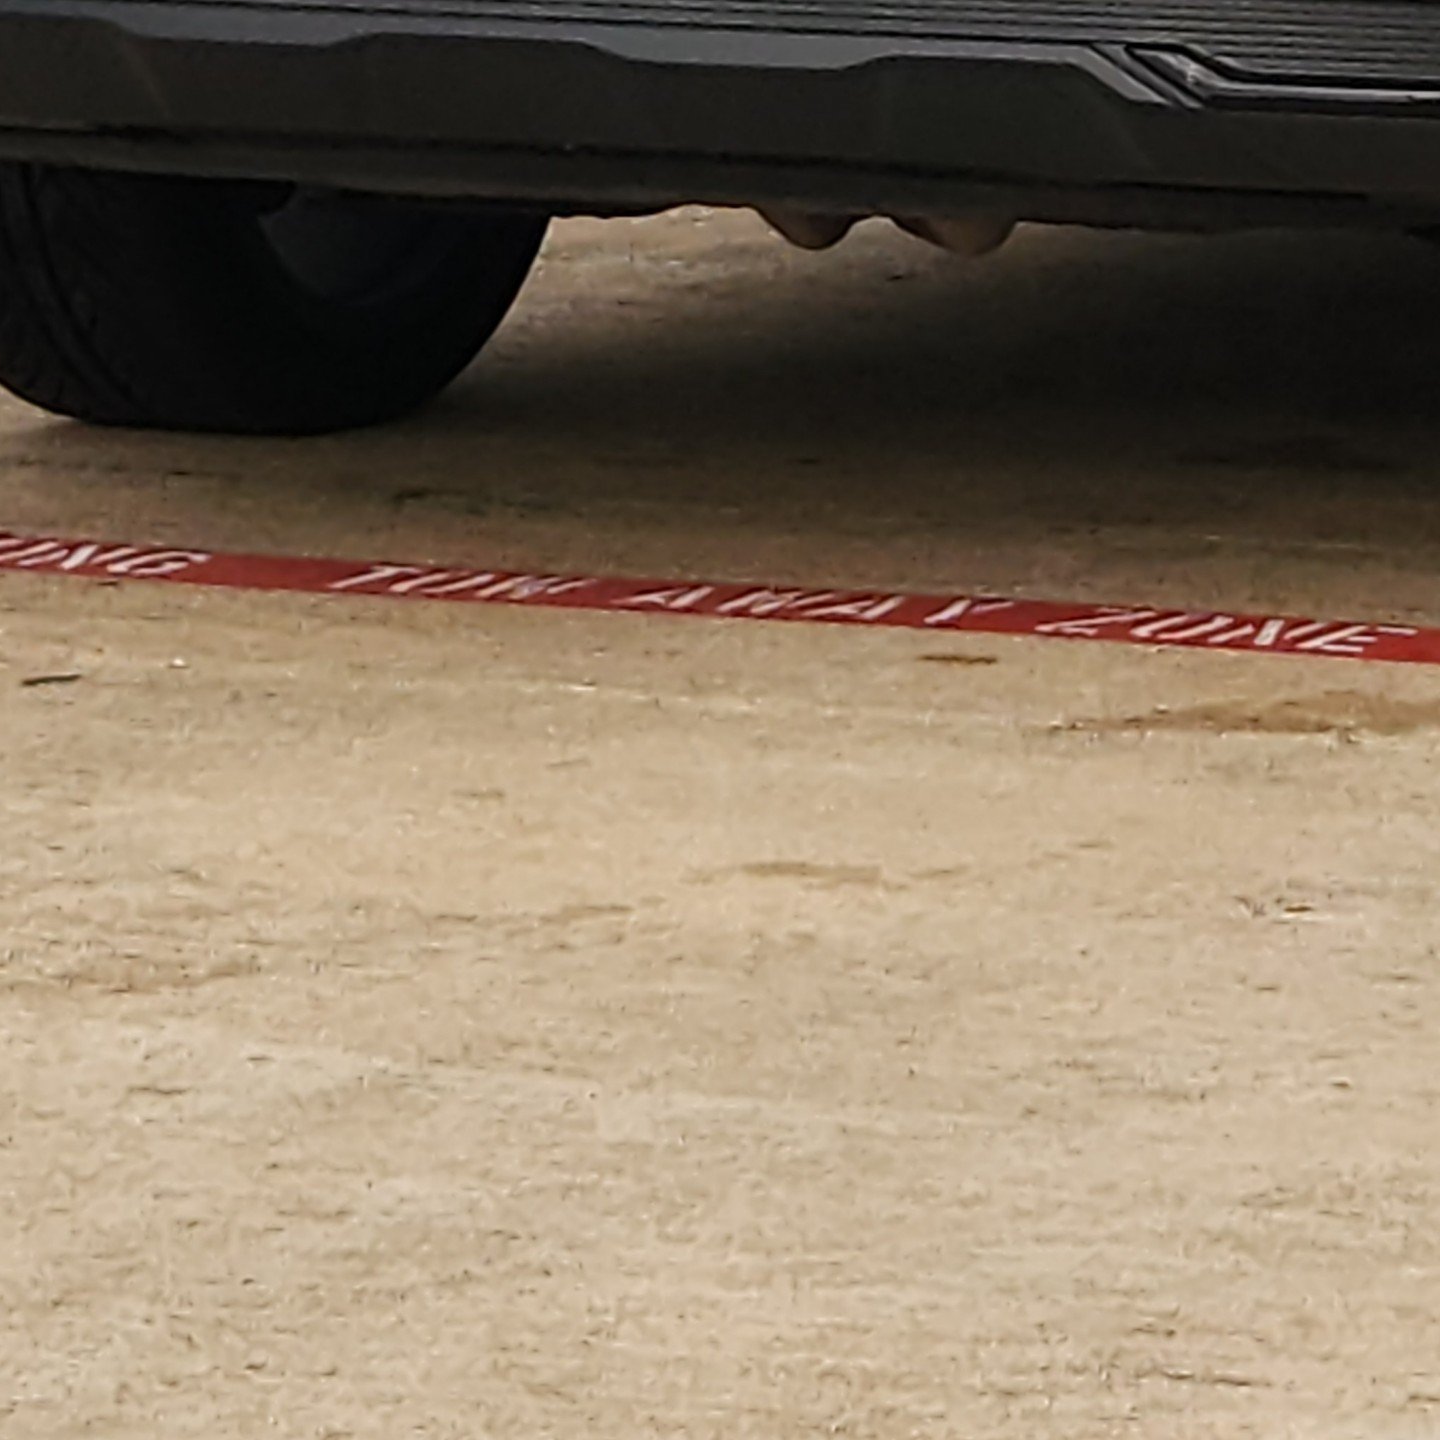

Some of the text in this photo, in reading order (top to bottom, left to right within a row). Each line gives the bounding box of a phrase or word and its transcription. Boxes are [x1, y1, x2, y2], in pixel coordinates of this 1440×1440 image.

[329, 565, 598, 599] TOW
[611, 585, 1015, 625] AWAY
[1035, 606, 1418, 653] ZONE
